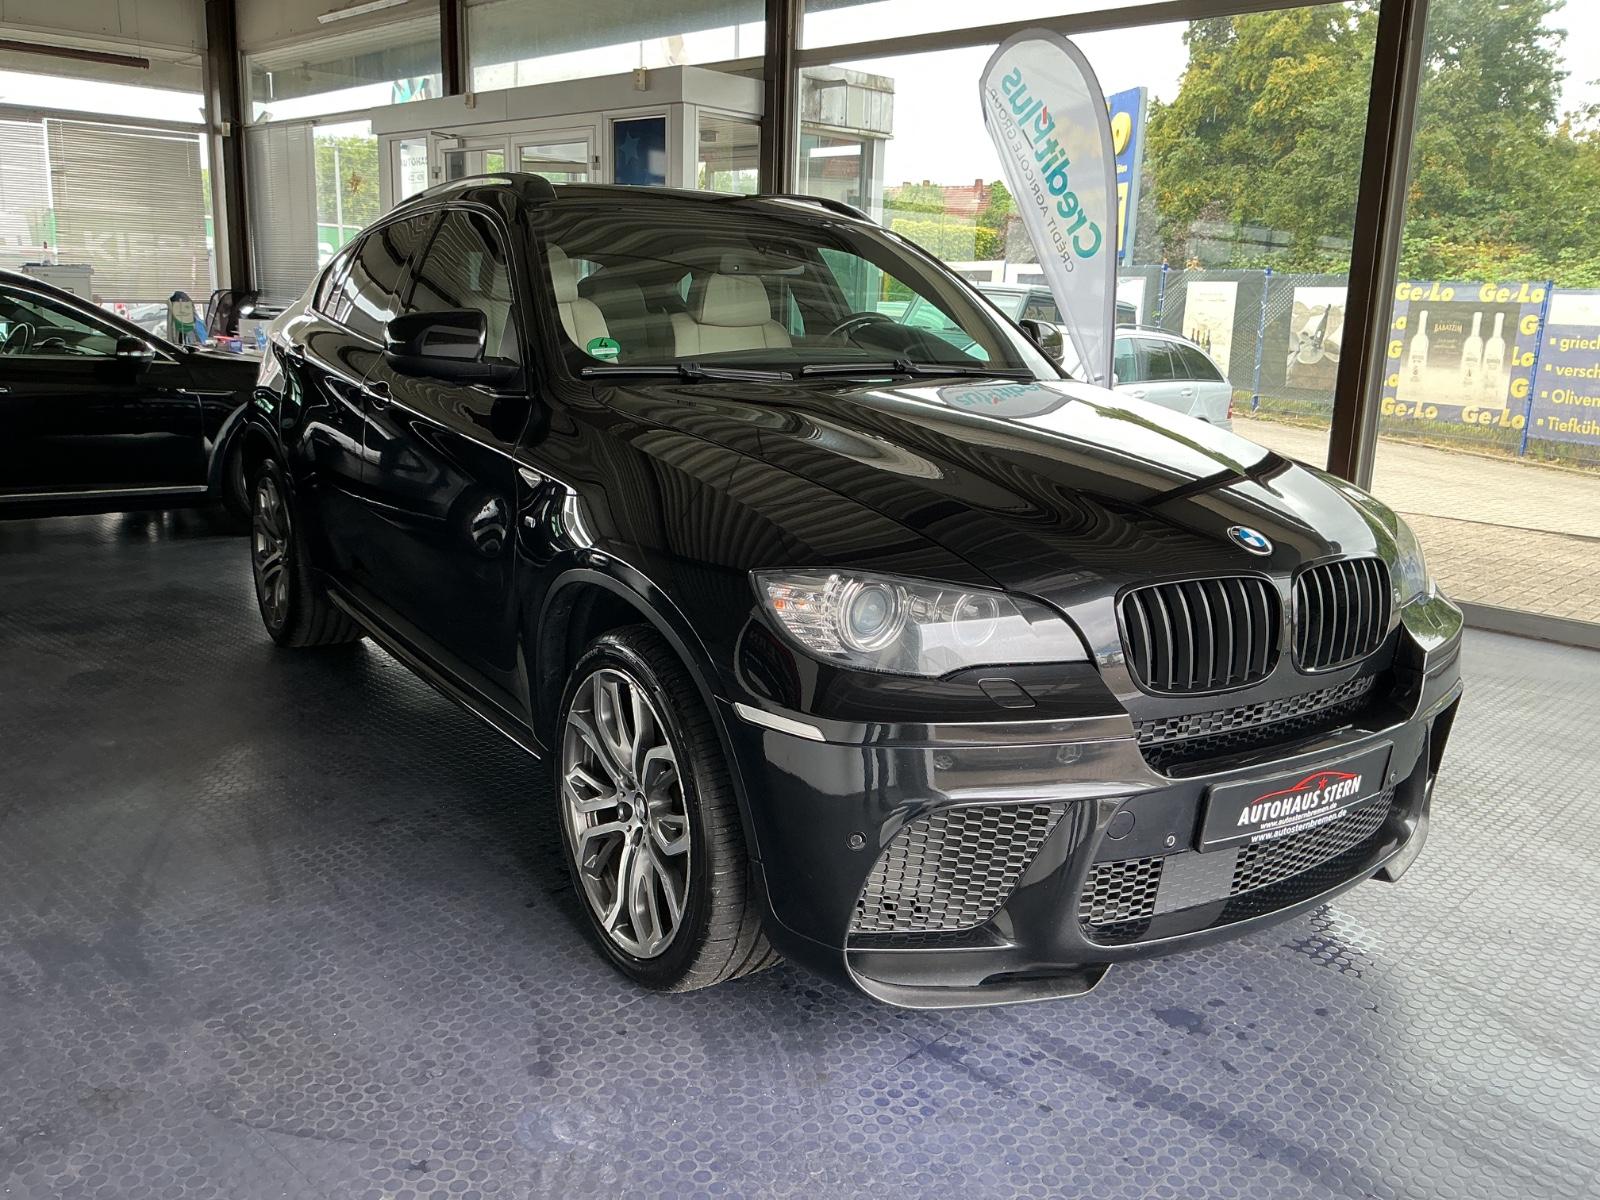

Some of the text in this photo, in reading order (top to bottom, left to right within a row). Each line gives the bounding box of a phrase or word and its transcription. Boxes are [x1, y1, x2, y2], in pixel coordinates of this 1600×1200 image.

[599, 338, 608, 349] 4
[1237, 775, 1362, 827] AUTOHAUS STERN
[1260, 802, 1338, 830] www.autosternbremen.de
[1251, 809, 1348, 843] www.autosternbremen.de
